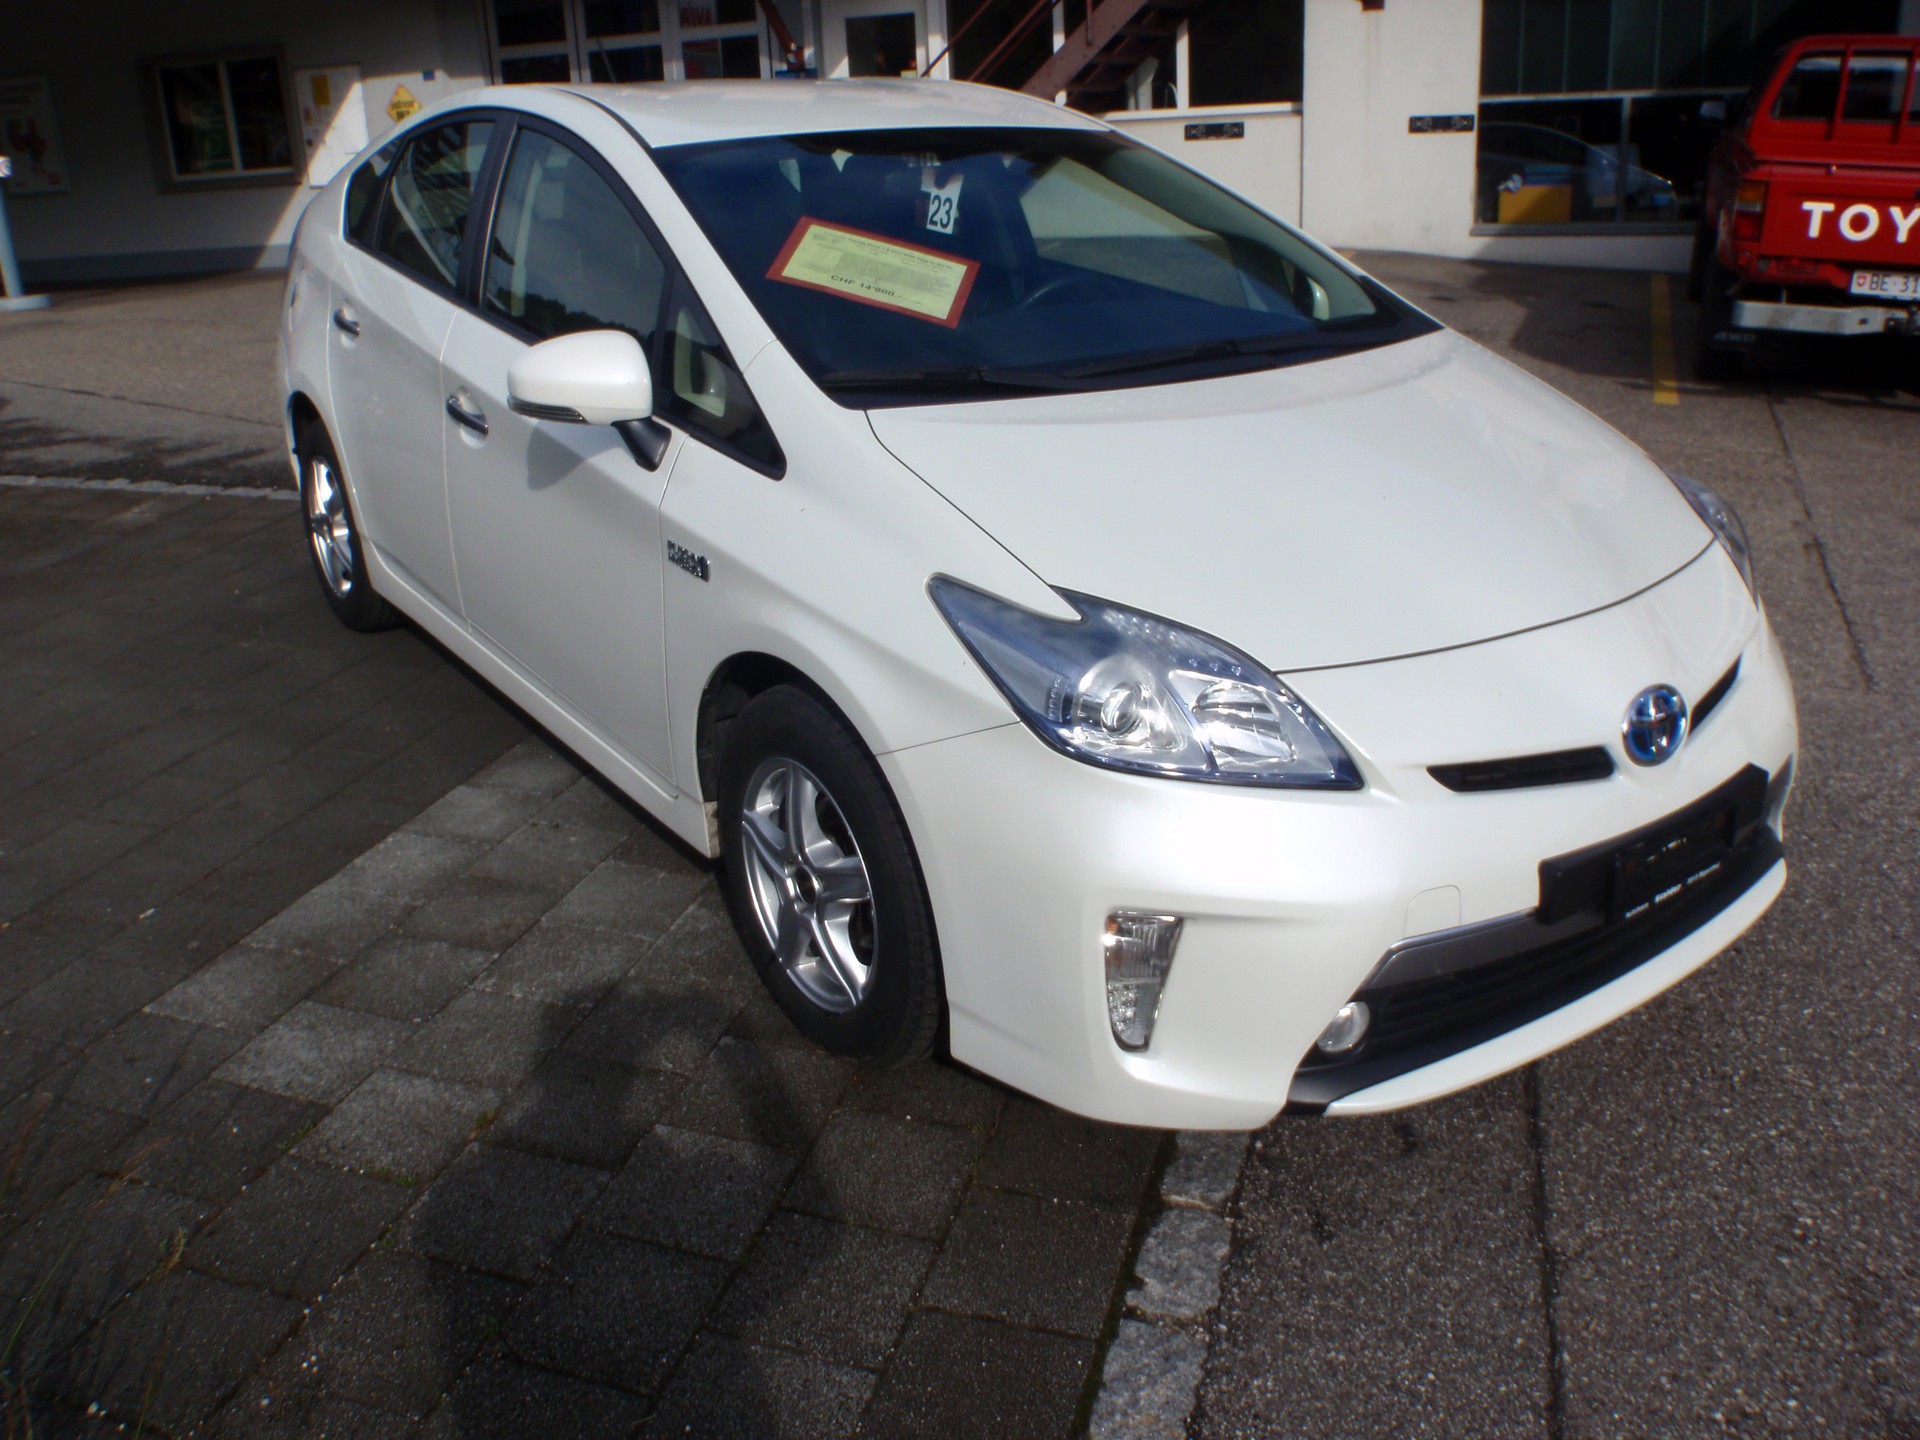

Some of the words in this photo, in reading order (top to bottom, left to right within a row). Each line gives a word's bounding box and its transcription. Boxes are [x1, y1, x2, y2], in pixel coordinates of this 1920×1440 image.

[928, 194, 953, 230] 23
[1801, 201, 1920, 244] TOY
[830, 274, 856, 285] CHF
